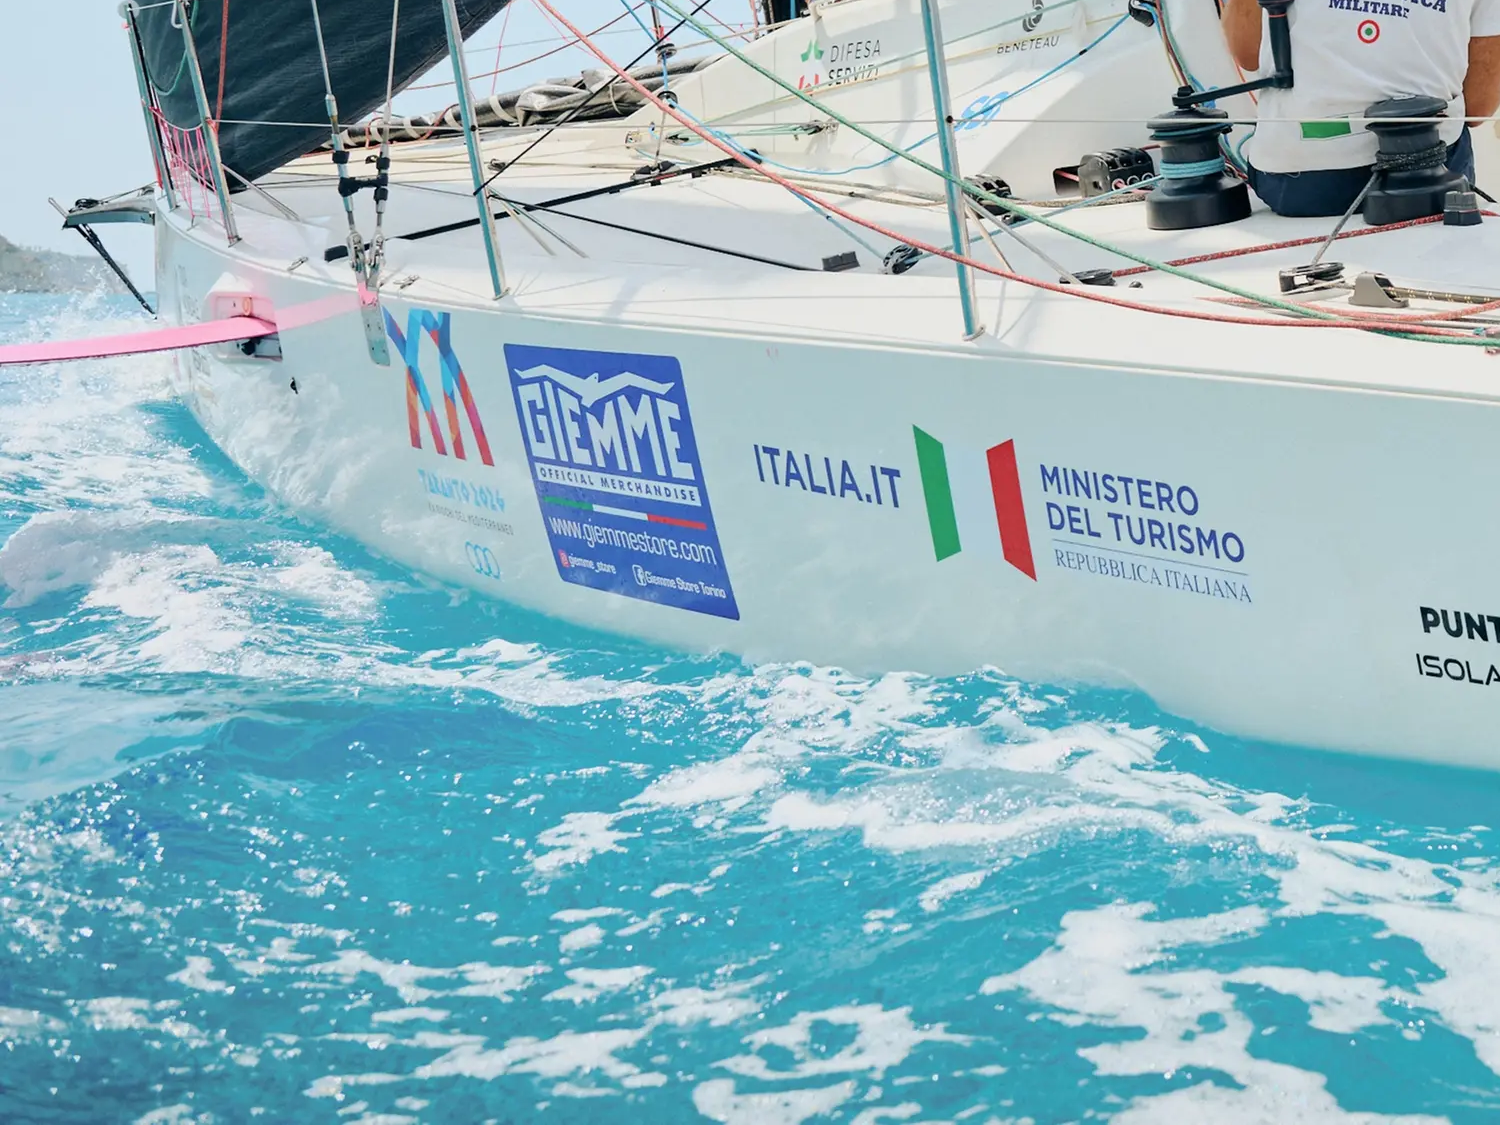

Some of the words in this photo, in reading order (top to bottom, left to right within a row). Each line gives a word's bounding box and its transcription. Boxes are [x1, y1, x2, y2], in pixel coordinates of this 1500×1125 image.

[830, 39, 881, 63] DIFESA
[996, 35, 1060, 55] BENETEAU
[517, 380, 696, 481] GIEMME
[539, 466, 595, 487] OFFICIAL
[600, 476, 696, 502] MERCHANDISE
[753, 443, 901, 508] ITALIA.IT
[1039, 463, 1199, 516] MINISTERO
[549, 516, 718, 566] www.giemmestore.com
[1046, 501, 1101, 539] DEL
[1107, 511, 1245, 564] TURISMO
[645, 571, 677, 589] Giemme
[677, 576, 700, 594] Store
[700, 581, 727, 599] Torino
[1055, 547, 1163, 588] REPUBBLICA
[1164, 567, 1253, 604] ITALIANA
